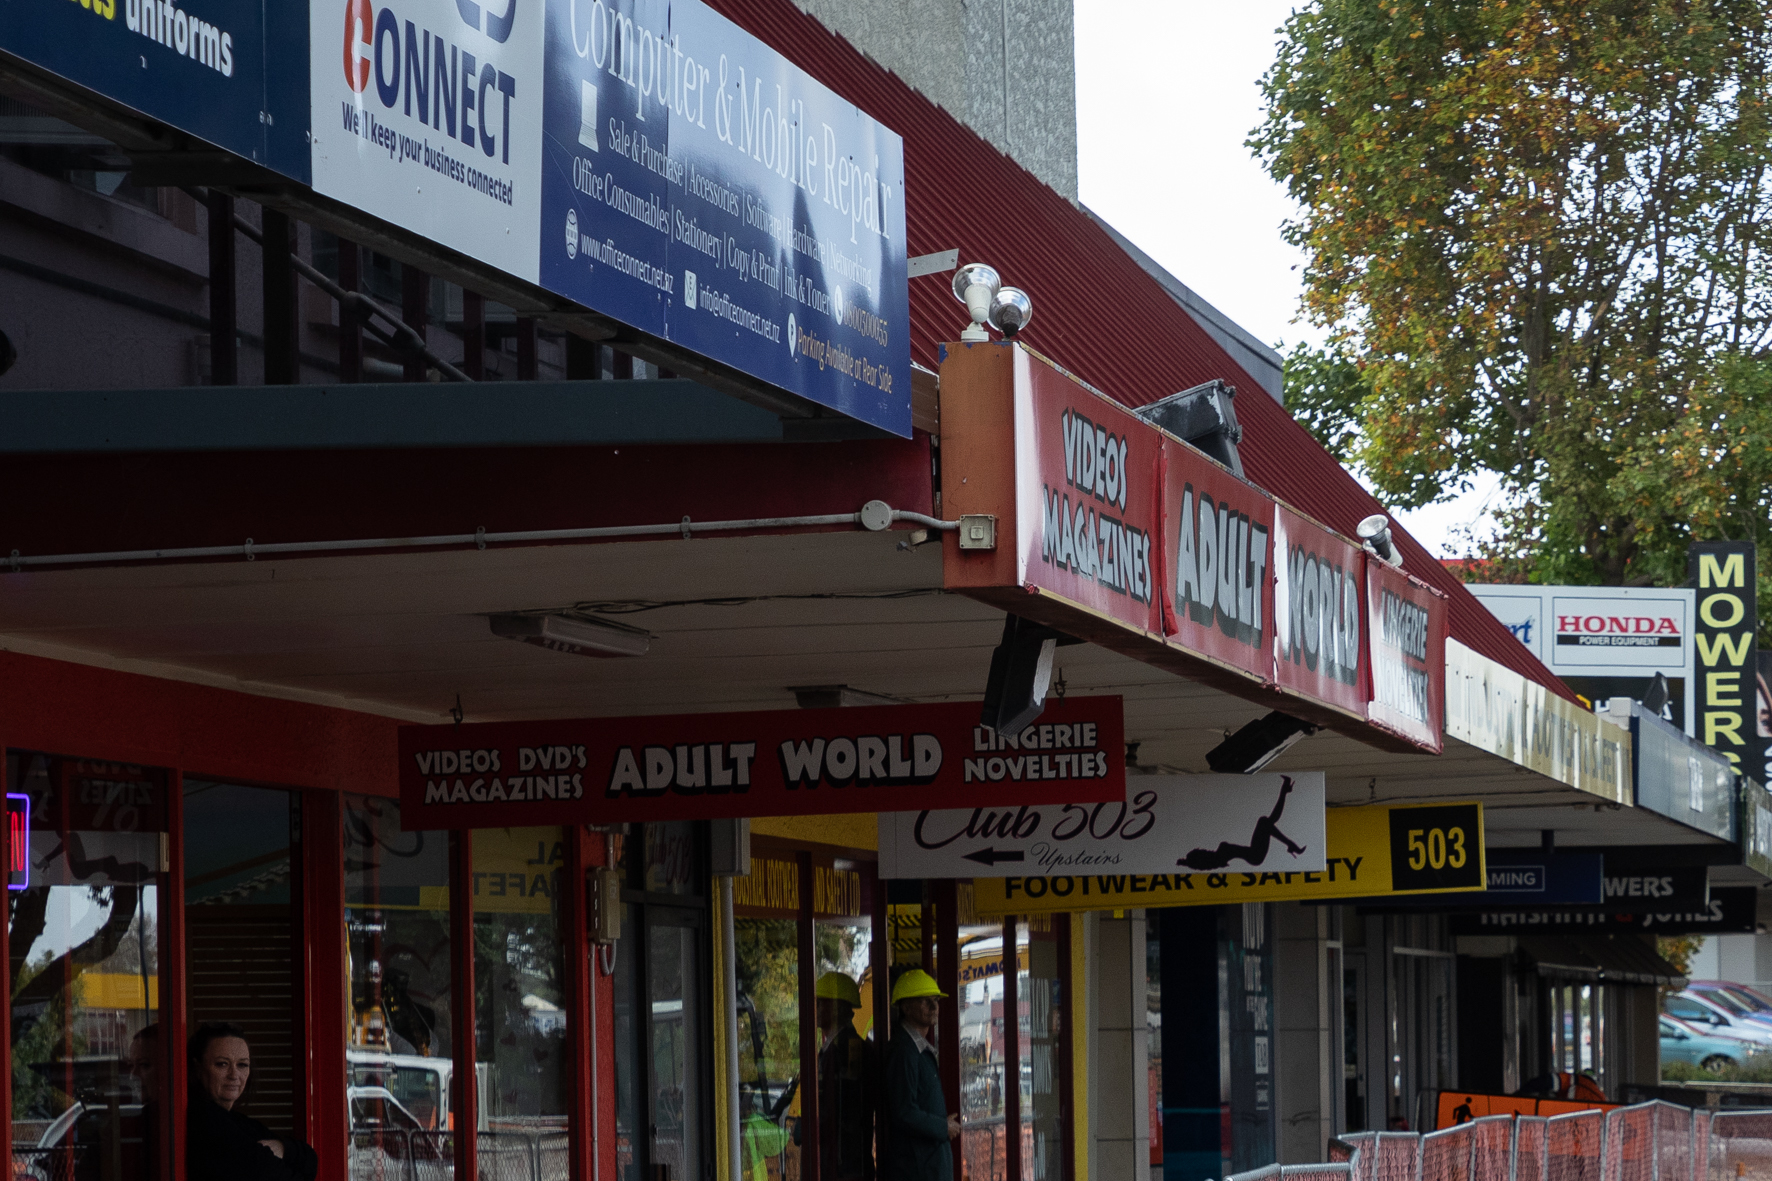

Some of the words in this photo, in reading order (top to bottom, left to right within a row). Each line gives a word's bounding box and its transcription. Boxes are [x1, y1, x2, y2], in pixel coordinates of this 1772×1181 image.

[125, 0, 233, 77] uniforms
[343, 0, 515, 165] CONNECT
[570, 0, 709, 129] Computer
[715, 54, 733, 146] &
[738, 65, 816, 196] Mobile
[822, 122, 891, 245] Repair
[370, 114, 396, 159] keep
[399, 133, 421, 163] your
[424, 138, 465, 184] business
[467, 166, 512, 206] connected
[573, 156, 603, 201] Office
[605, 173, 669, 234] Consumables
[676, 209, 722, 268] Stationery
[728, 237, 750, 282] Copy
[759, 252, 780, 291] Print
[785, 267, 798, 300] Ink
[806, 278, 830, 315] Toner
[609, 117, 629, 158] Sale
[631, 129, 640, 164] &
[641, 133, 683, 187] Purchase
[688, 163, 738, 217] Accessories
[747, 194, 782, 241] Software
[787, 217, 826, 265] Hardware
[831, 242, 872, 298] Networking
[581, 233, 674, 294] www.officeconnect.net.nz
[700, 283, 781, 344] info@officeconnect.net.nz
[798, 326, 825, 371] Parking
[825, 340, 854, 377] Available
[862, 358, 878, 386] Rear
[878, 364, 892, 394] Side
[1062, 406, 1127, 516] VIDEOS
[1042, 483, 1152, 608] MAGAZINES
[1175, 482, 1268, 650] ADULT
[1283, 540, 1360, 687] WORLD
[1557, 616, 1681, 635] HONDA
[1579, 635, 1609, 646] POWER
[1611, 635, 1660, 647] EQUIPMENT
[1694, 554, 1754, 776] MOWERS
[415, 749, 500, 776] VIDEOS
[518, 745, 588, 771] DVD'S
[605, 742, 756, 797] ADULT
[777, 734, 943, 787] WORLD
[972, 723, 1098, 752] LINGERIE
[424, 774, 584, 804] MAGAZINES
[963, 750, 1107, 784] NOVELTIES
[914, 803, 1042, 851] Club
[1051, 790, 1158, 842] 503
[1029, 841, 1124, 874] Upstairs
[1406, 827, 1467, 871] 503
[1005, 873, 1195, 899] FOOTWEAR
[1240, 856, 1364, 887] SAFETY
